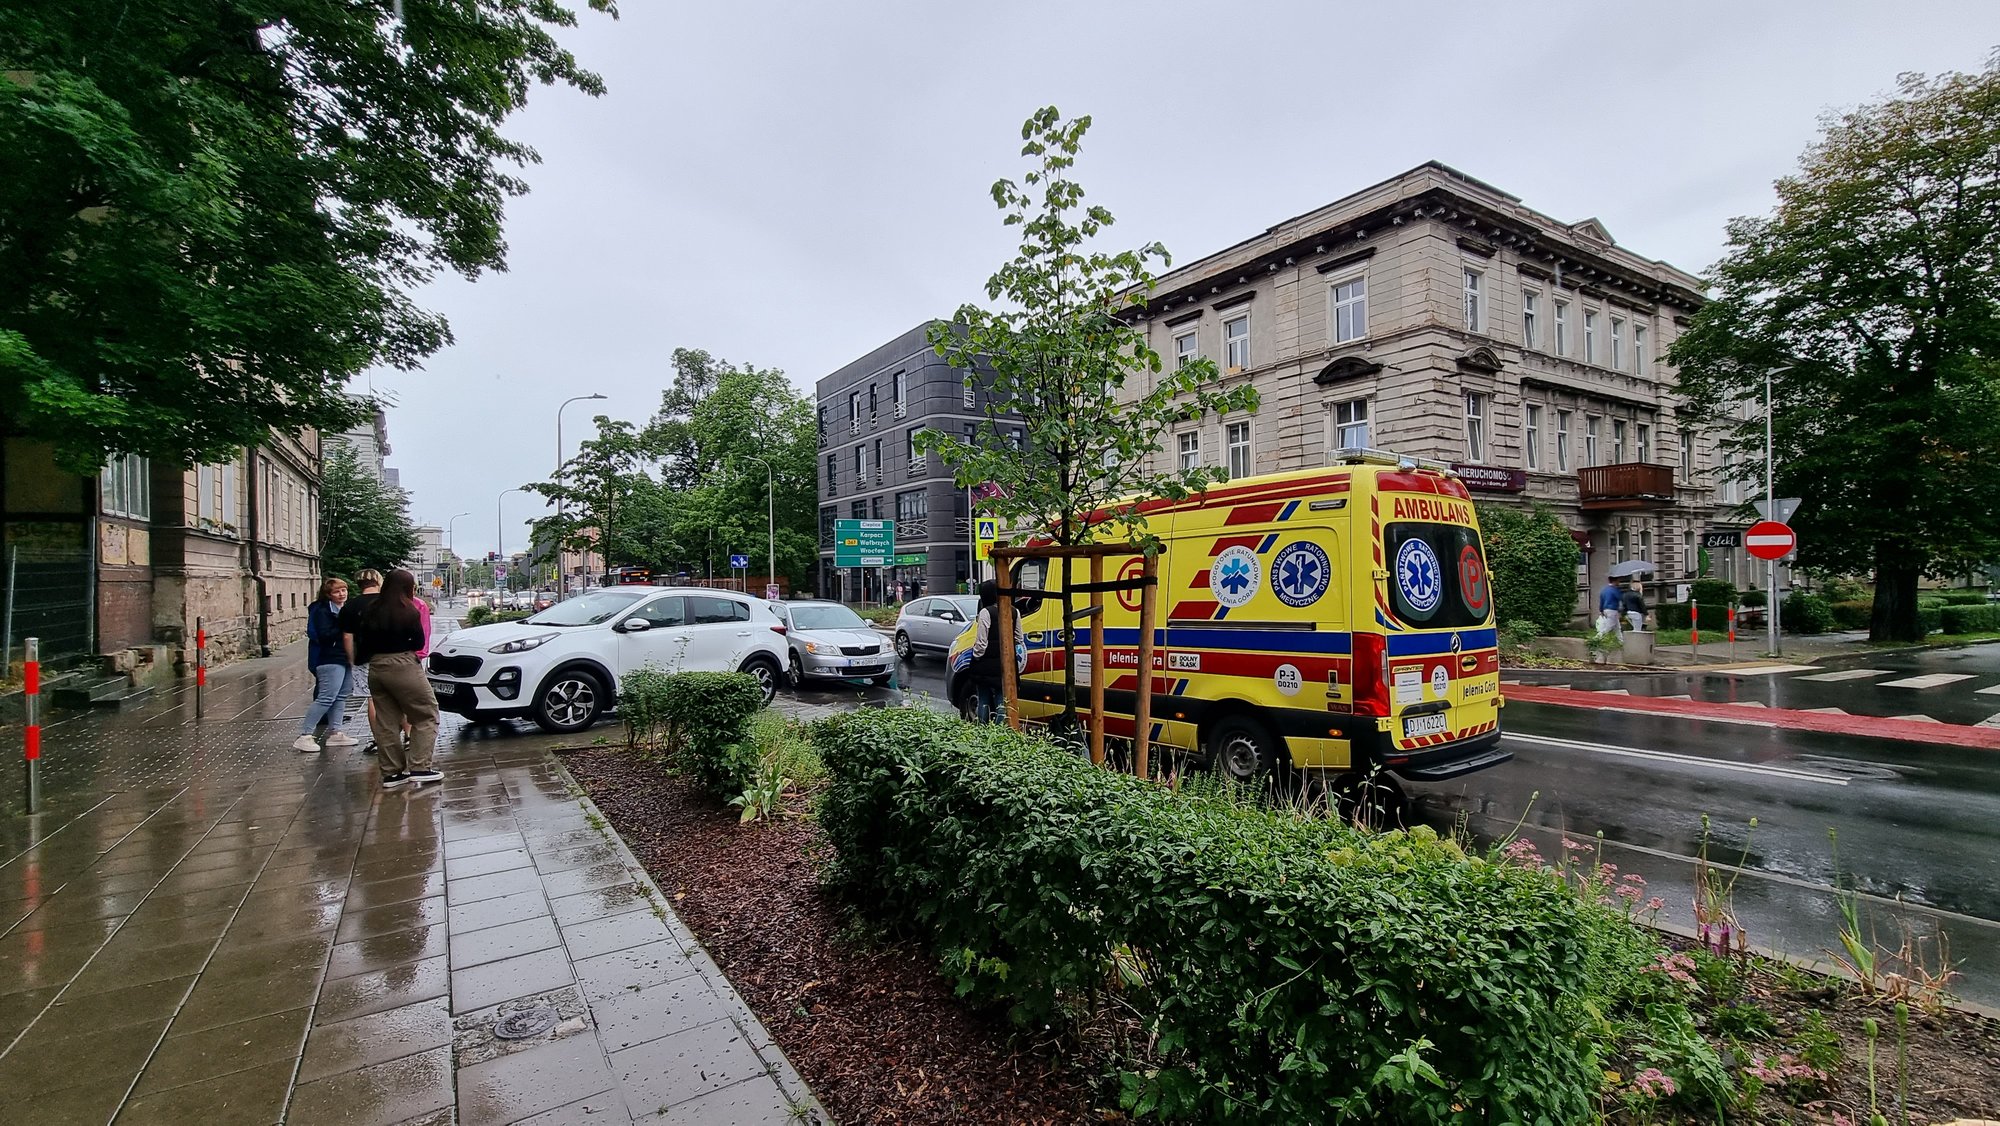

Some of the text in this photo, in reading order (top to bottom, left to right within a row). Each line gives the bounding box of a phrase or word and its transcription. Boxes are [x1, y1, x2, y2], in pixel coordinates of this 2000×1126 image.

[1394, 497, 1470, 524] AMBULANS
[1707, 535, 1736, 546] Efekt
[1212, 548, 1259, 586] POGOTOWIE RATUNKOWE
[1418, 542, 1440, 592] RATOWNICTWO
[1272, 543, 1329, 606] PAŃSTWOWE RATOWNICTWO MEDYCZNE
[1467, 558, 1480, 597] P
[1215, 589, 1237, 604] JELENIA
[1409, 593, 1436, 607] MEDYCZNE
[1109, 651, 1138, 664] Jelenia
[1279, 669, 1296, 681] P-3
[1434, 671, 1445, 682] P-3
[1278, 680, 1298, 689] D0210
[1463, 681, 1496, 700] Jelenia Góra
[1409, 719, 1419, 732] DJ
